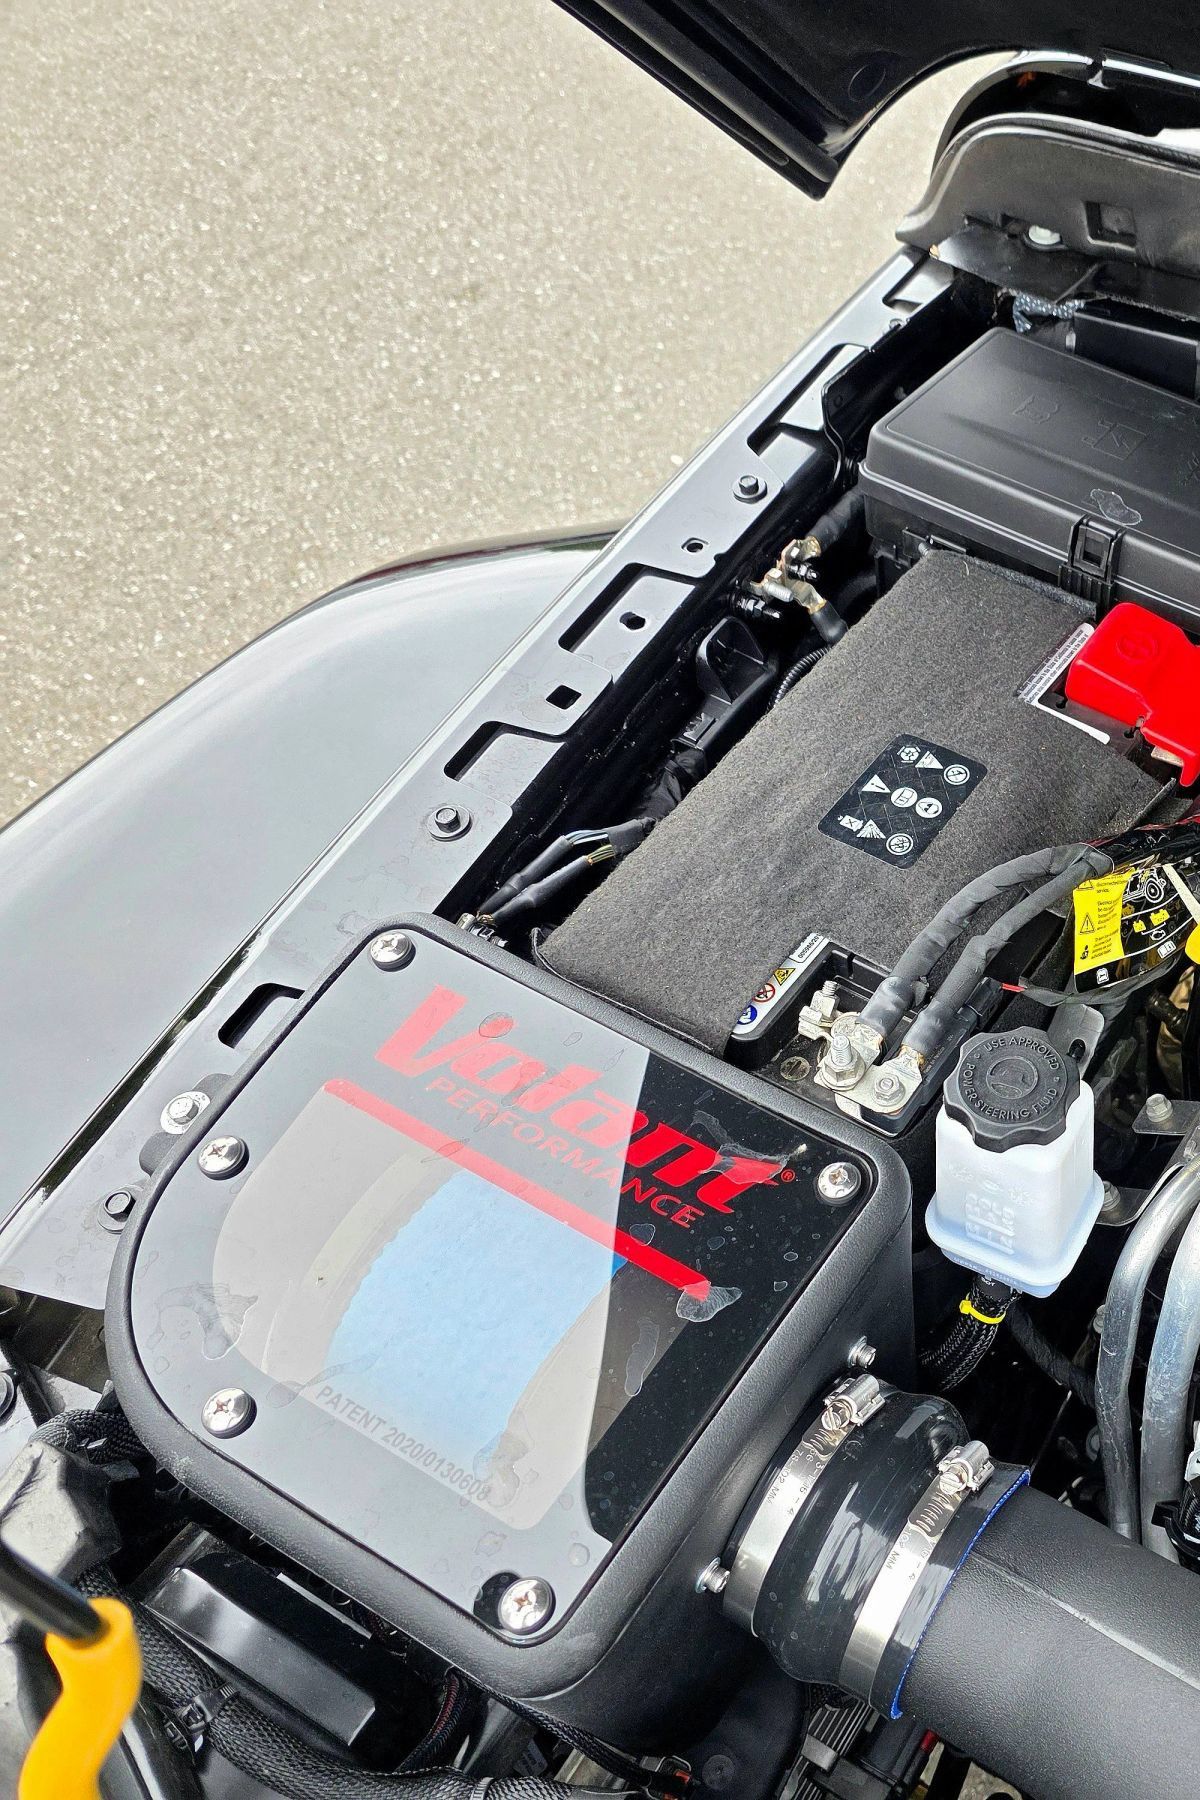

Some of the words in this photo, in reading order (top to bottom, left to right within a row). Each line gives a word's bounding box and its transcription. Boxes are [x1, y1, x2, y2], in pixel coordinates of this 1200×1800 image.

[375, 983, 780, 1214] Volant
[962, 1063, 977, 1103] POWER
[974, 1099, 1031, 1121] STEERING
[1033, 1088, 1058, 1116] FLUID
[983, 1037, 1007, 1052] USE
[1009, 1036, 1061, 1071] APPROVED
[427, 1076, 706, 1228] PERFORMANCE
[316, 1385, 387, 1442] PATENT
[381, 1426, 493, 1502] 2020/0130608
